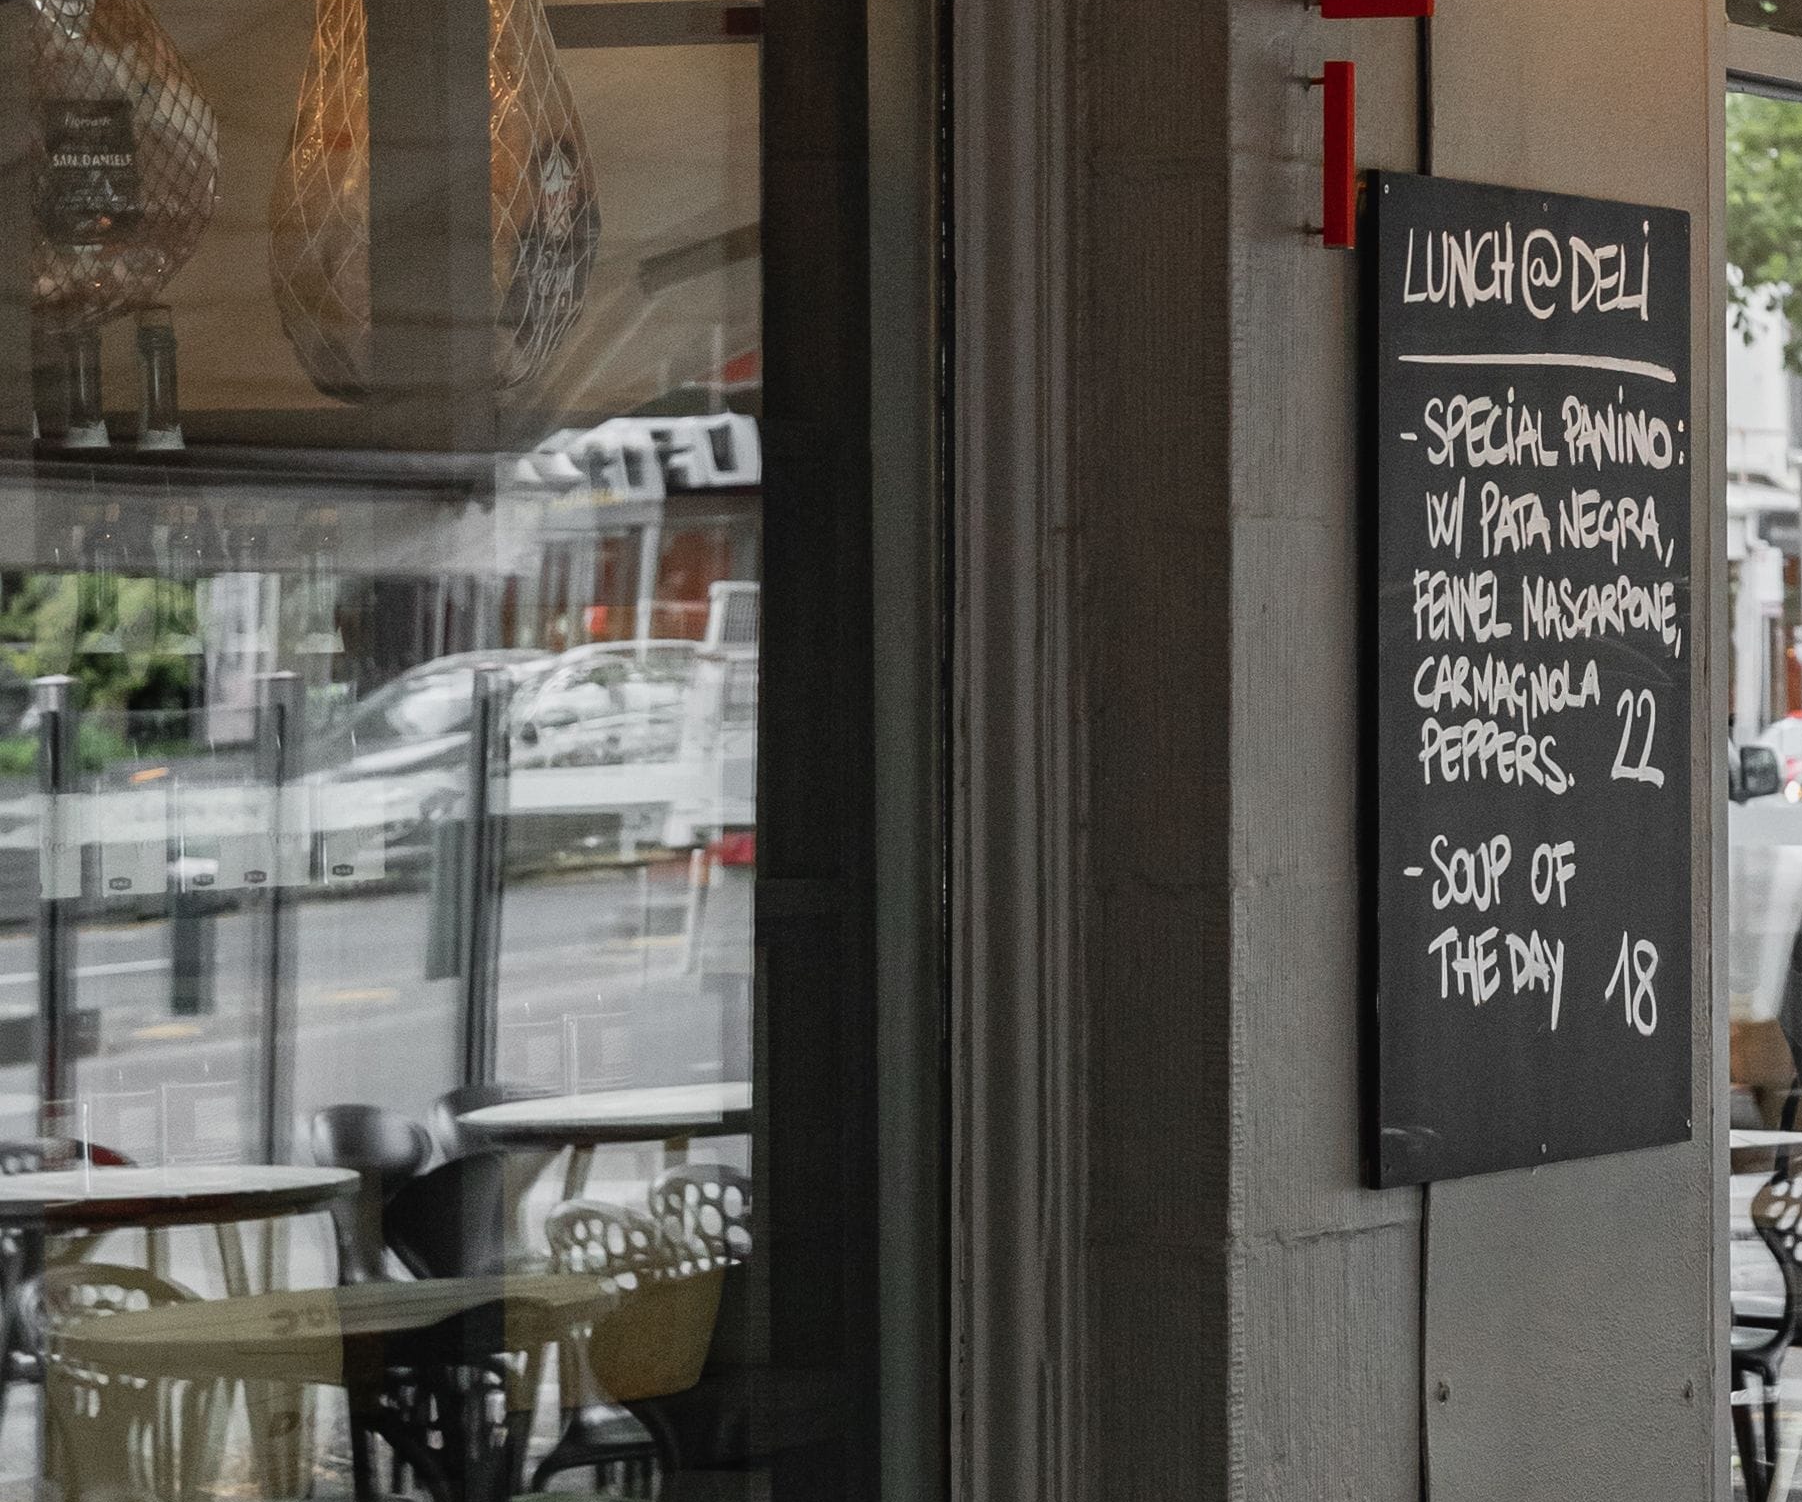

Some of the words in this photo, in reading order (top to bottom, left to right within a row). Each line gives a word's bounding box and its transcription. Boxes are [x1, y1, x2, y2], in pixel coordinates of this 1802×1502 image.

[1404, 221, 1515, 309] LUNCH
[1480, 481, 1552, 559] PATA
[1558, 486, 1675, 568] NEGRA,
[1413, 568, 1513, 644] FENNEL
[1522, 574, 1682, 659] MASCARPONE,
[1413, 652, 1600, 736] CARMAGNOLA
[1419, 717, 1576, 795] PEPPERS.
[1610, 687, 1665, 789] 22
[1430, 833, 1513, 912] SOUP
[1530, 839, 1577, 908] OF
[1427, 925, 1501, 1007] THE
[1504, 928, 1565, 1032] DAY
[1604, 930, 1659, 1036] 18
